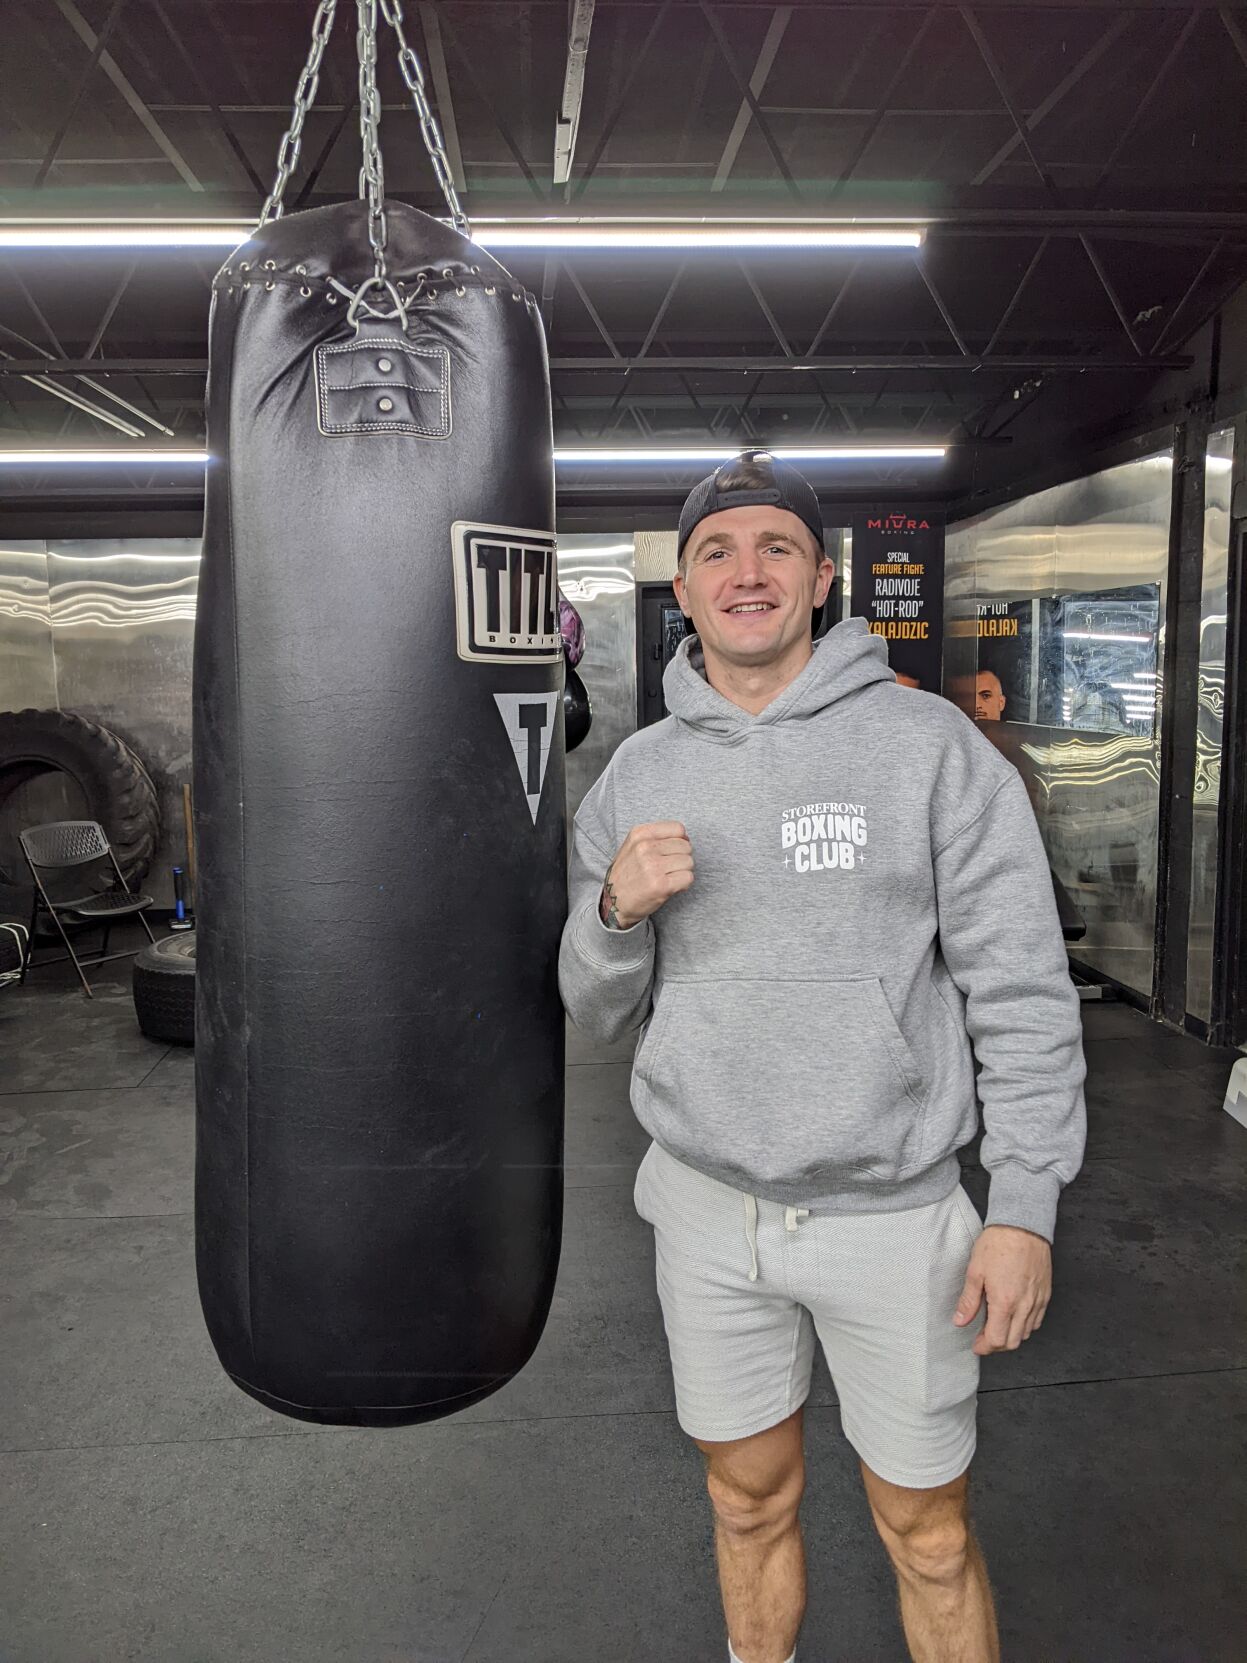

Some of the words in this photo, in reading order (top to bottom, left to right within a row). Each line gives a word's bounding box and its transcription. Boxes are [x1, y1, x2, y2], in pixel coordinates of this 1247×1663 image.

[867, 519, 929, 529] MIURA
[887, 552, 910, 563] SPECIAL
[872, 564, 902, 575] FEATURE
[875, 579, 921, 596] RADIVOJE
[781, 802, 867, 822] STOREFRONT
[781, 814, 868, 849] BOXING
[795, 841, 855, 873] CLUB
